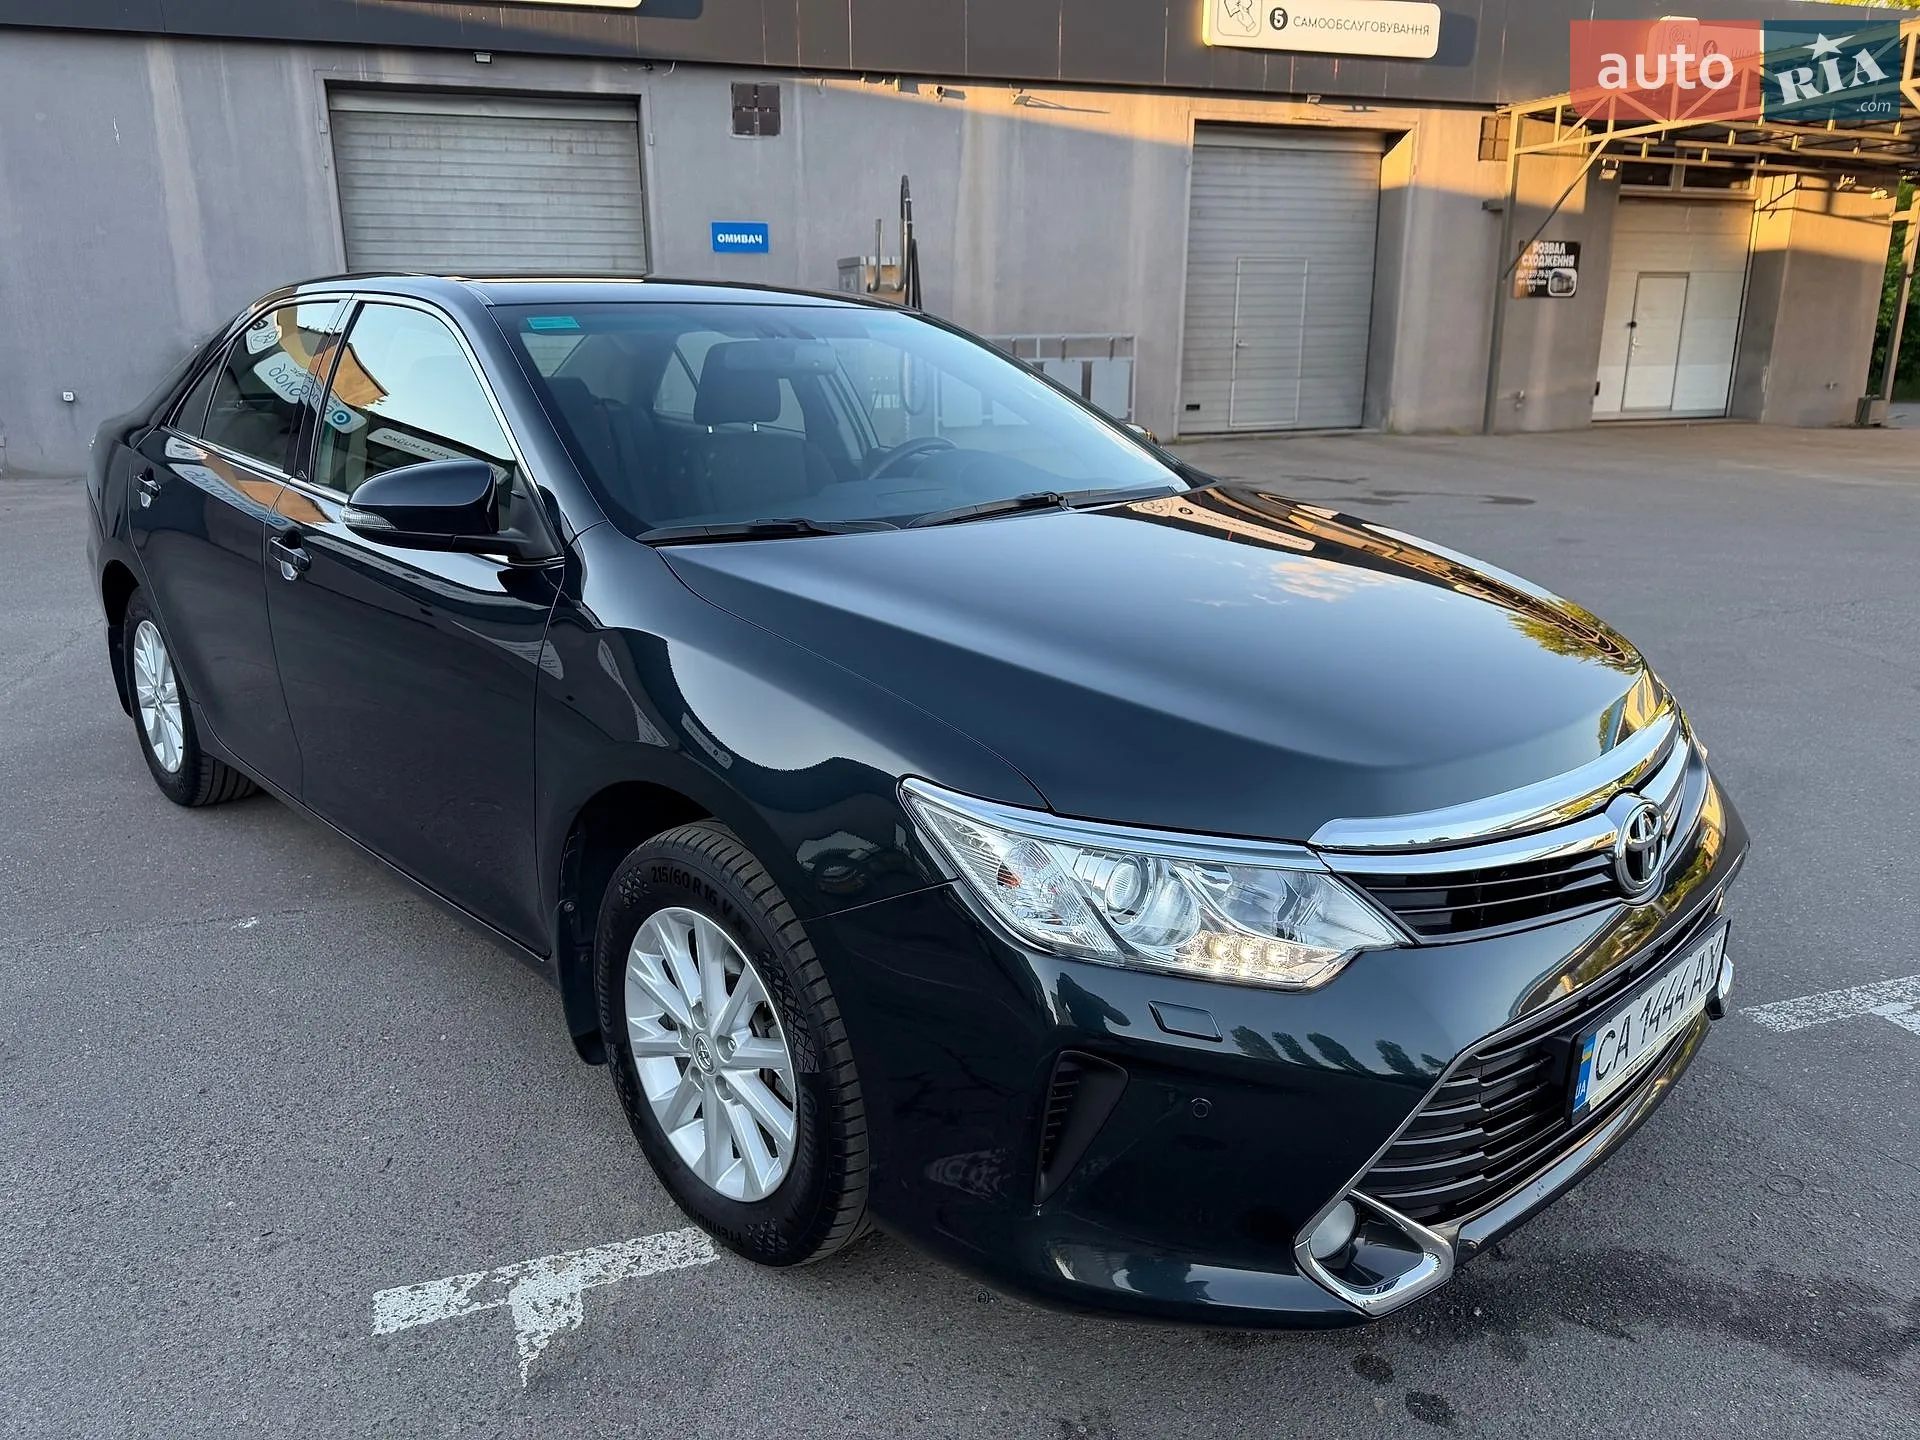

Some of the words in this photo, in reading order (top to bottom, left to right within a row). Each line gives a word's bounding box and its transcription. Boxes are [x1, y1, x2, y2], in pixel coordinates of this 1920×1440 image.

[1272, 9, 1285, 28] 5
[1293, 16, 1430, 35] САМООБСЛУГОВУВАННЯ
[717, 233, 763, 245] ОМИВАЧ
[1532, 241, 1566, 254] РОЗВАЛ
[1521, 254, 1575, 268] СХОДЖЕННЯ
[651, 866, 690, 889] 215/60
[693, 877, 702, 896] R
[704, 883, 718, 906] 16
[1596, 1014, 1631, 1081] CA
[1640, 963, 1690, 1045] 1444
[1689, 935, 1722, 1002] AX
[1575, 1082, 1587, 1099] UA
